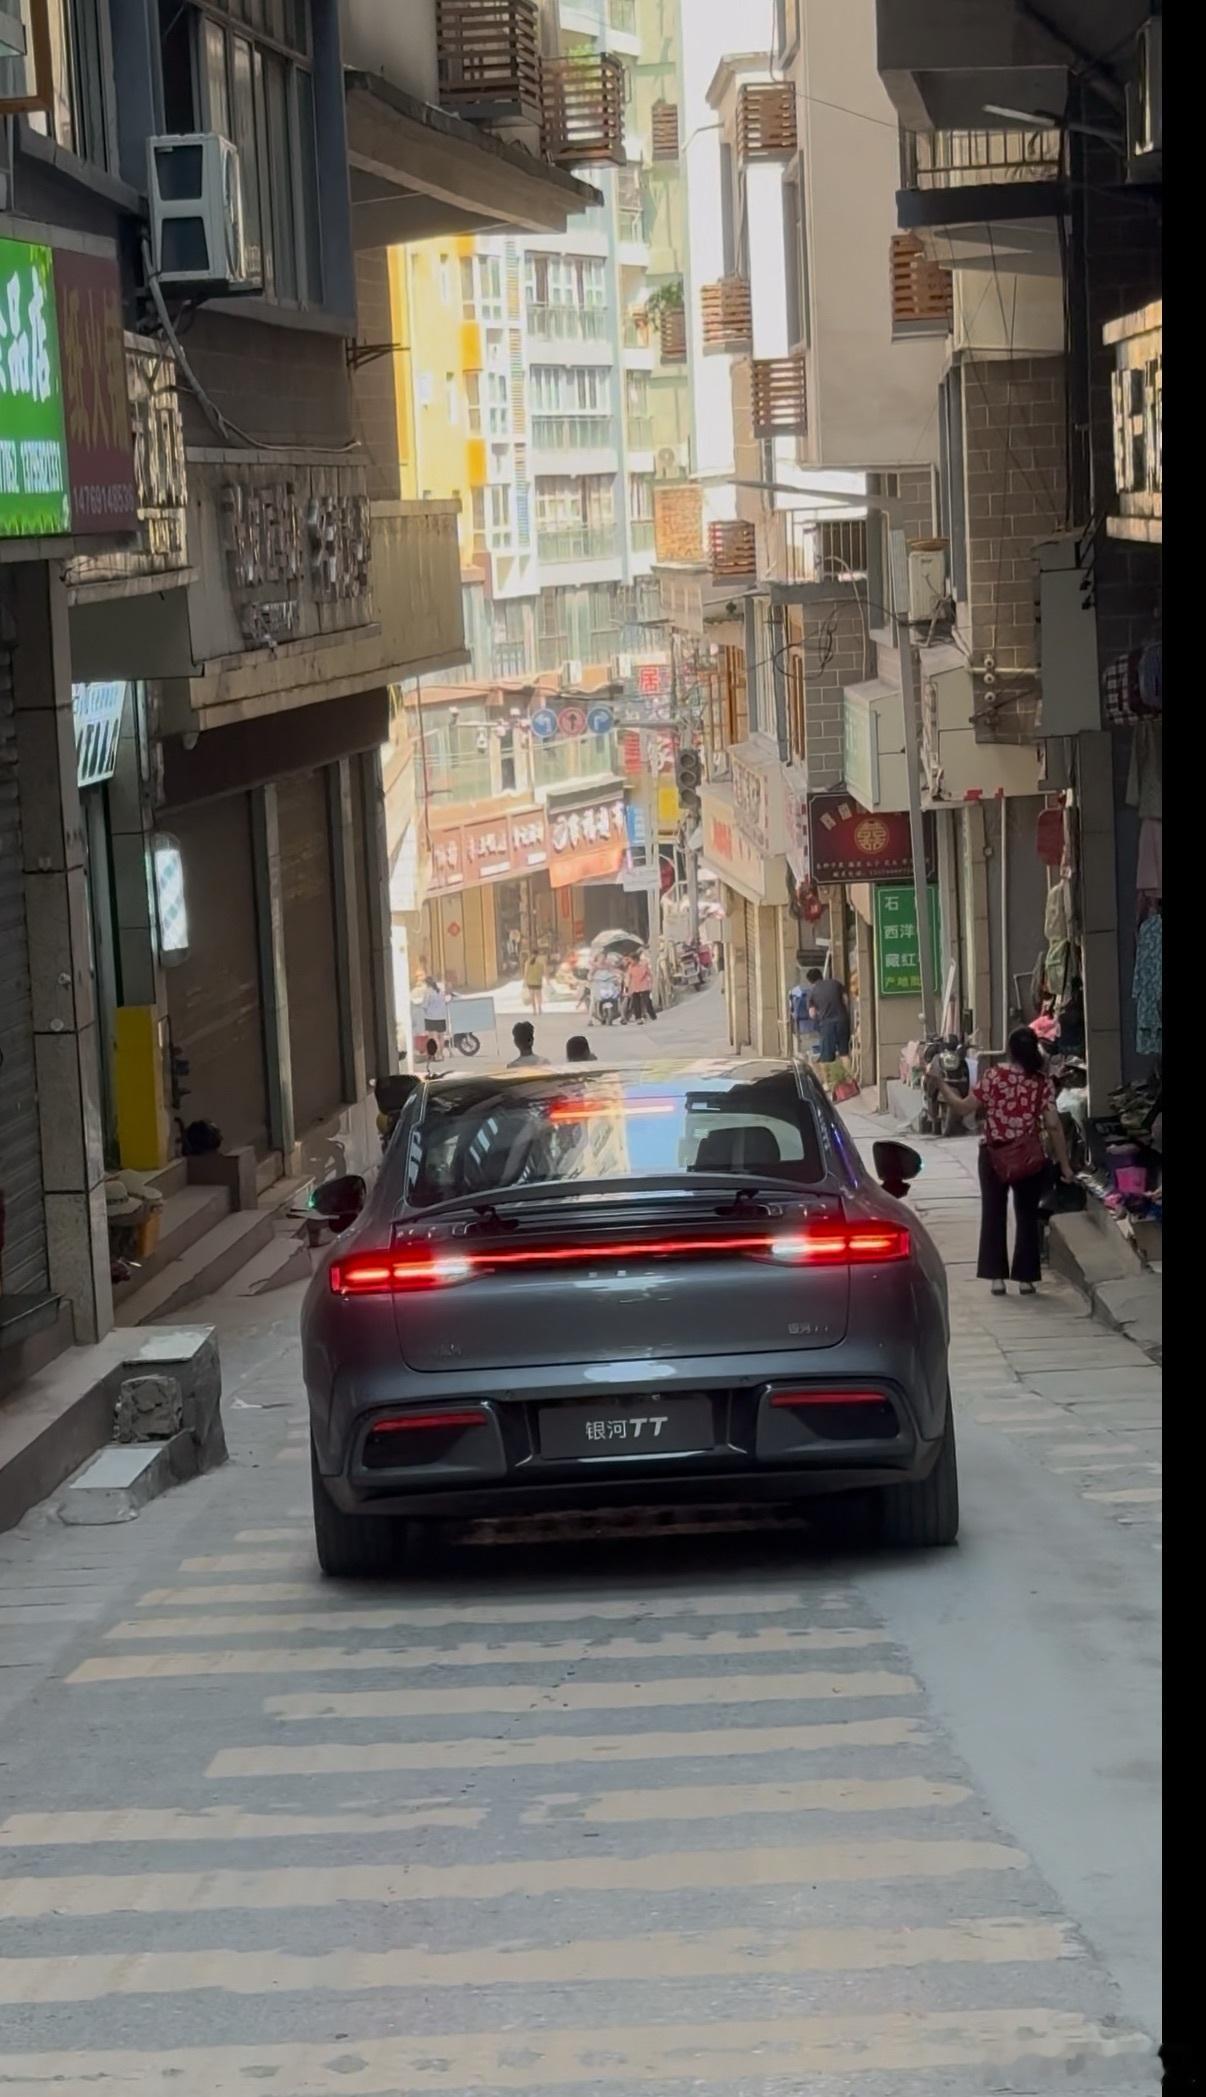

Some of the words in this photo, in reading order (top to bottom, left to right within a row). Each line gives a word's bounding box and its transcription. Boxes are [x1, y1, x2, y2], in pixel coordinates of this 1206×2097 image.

[0, 265, 50, 402] 品店
[883, 924, 914, 939] 西洋
[585, 1416, 669, 1440] 银河TT
